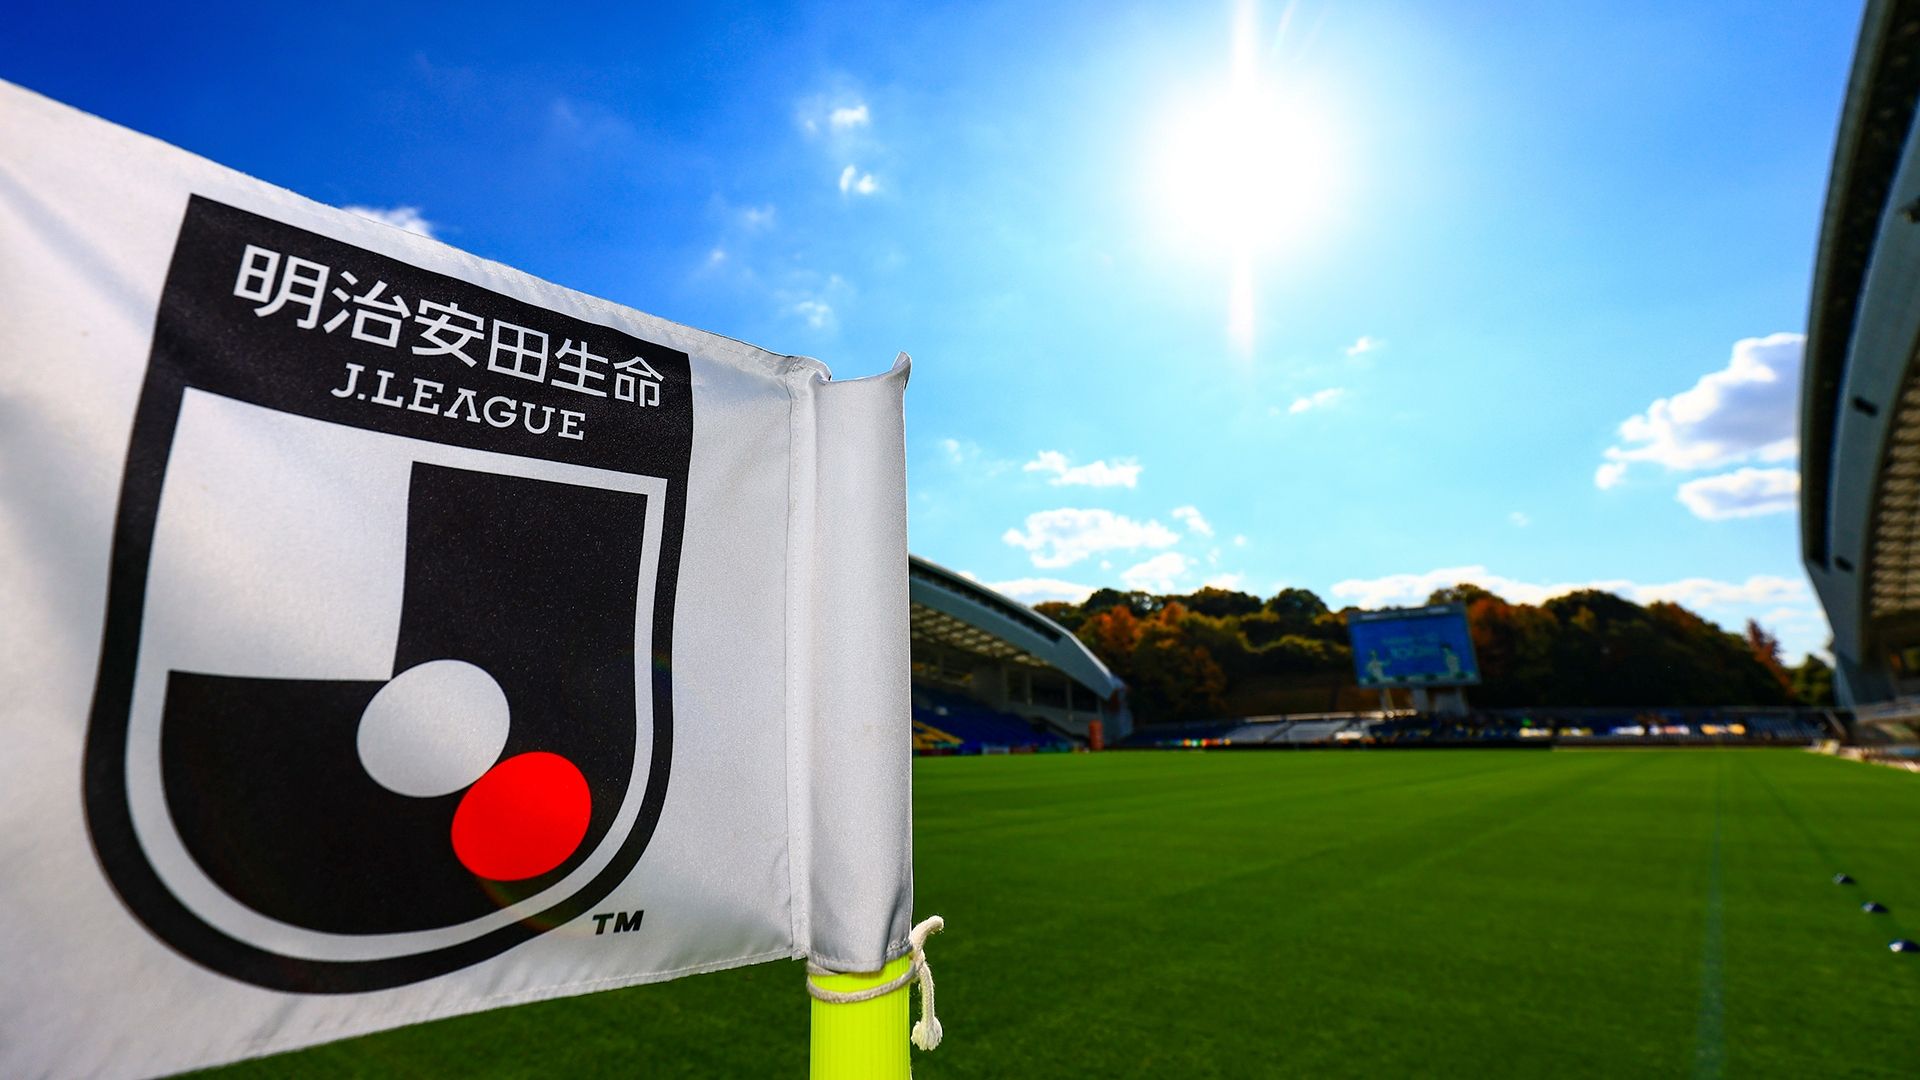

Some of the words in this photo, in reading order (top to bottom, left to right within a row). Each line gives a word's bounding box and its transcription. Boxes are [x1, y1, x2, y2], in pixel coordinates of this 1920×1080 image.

[233, 244, 665, 408] 明治安田生命
[330, 362, 586, 441] J.LEAGUE
[592, 909, 645, 935] TM
